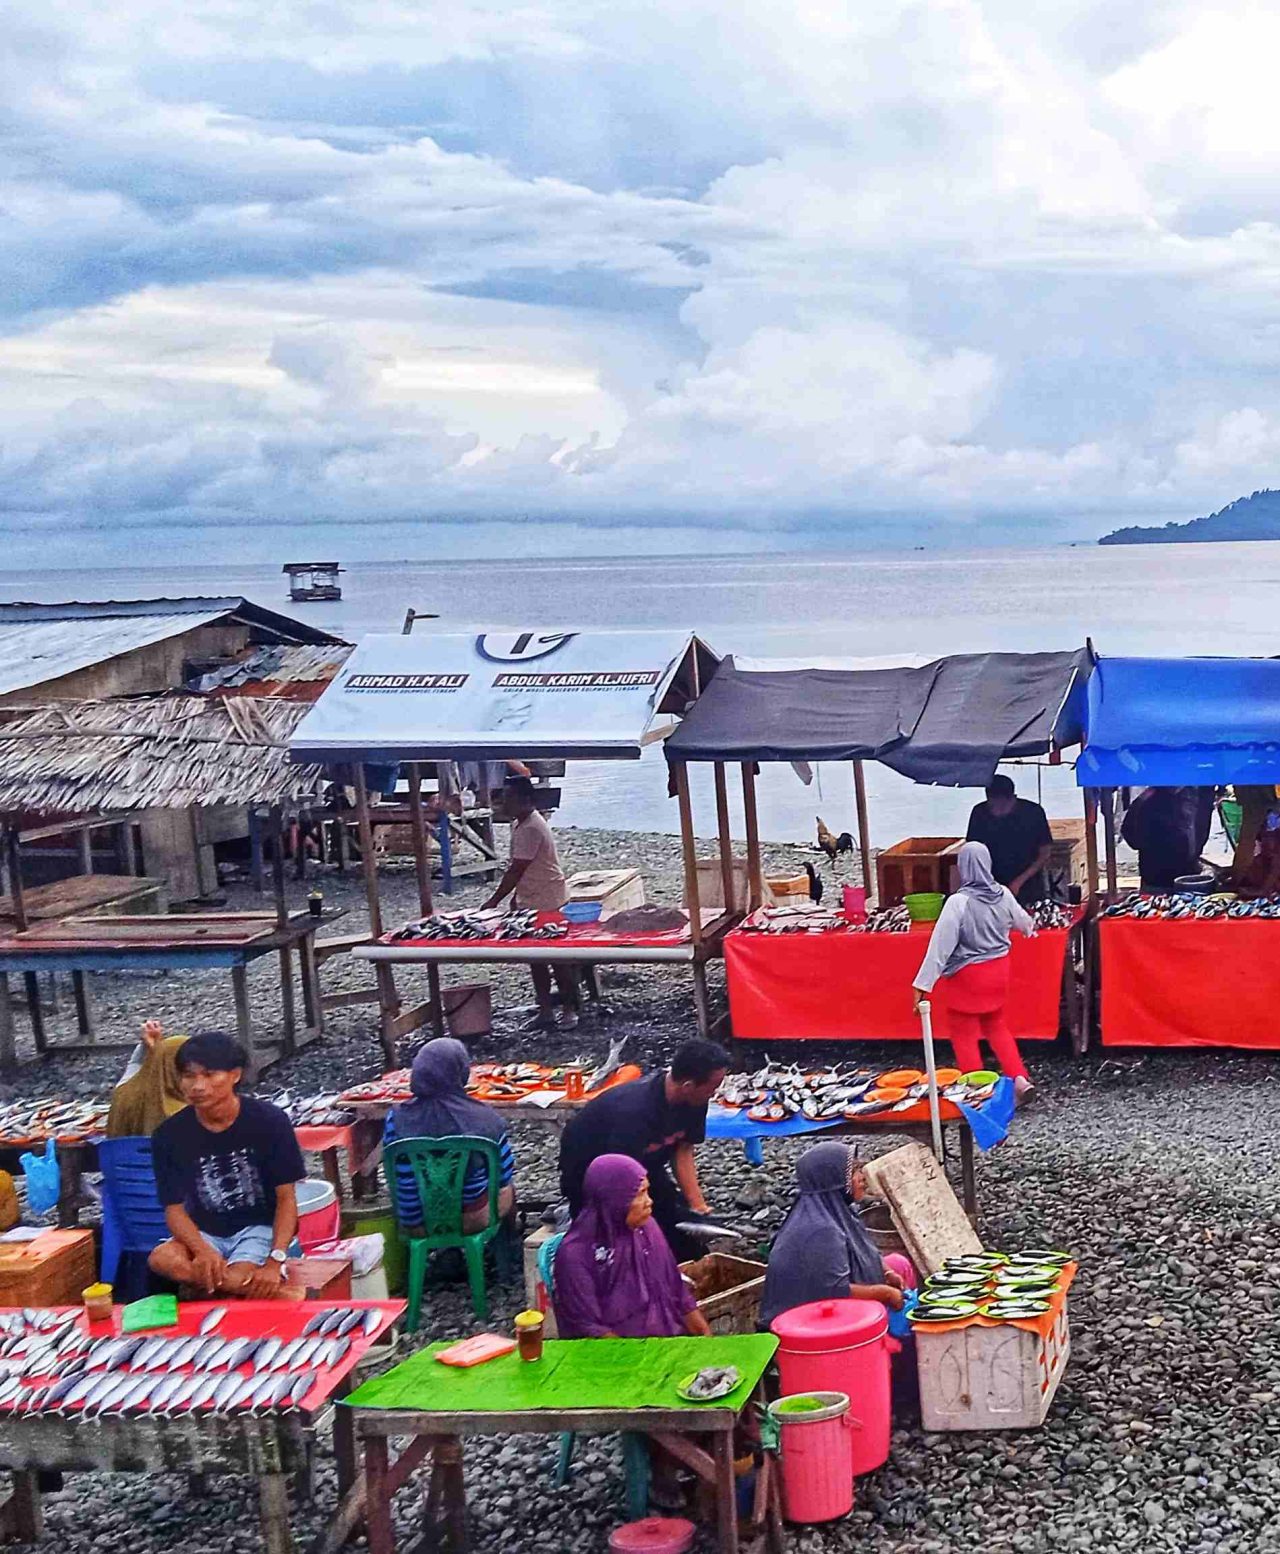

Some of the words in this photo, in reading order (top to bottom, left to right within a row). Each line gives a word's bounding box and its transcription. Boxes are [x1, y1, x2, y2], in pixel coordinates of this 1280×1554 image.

[348, 676, 405, 687] AHMAD
[405, 676, 437, 687] H.M
[435, 676, 465, 687] ALI
[497, 675, 544, 686] ABDUL
[546, 674, 594, 686] KARIM
[592, 673, 655, 685] ALJUFRI
